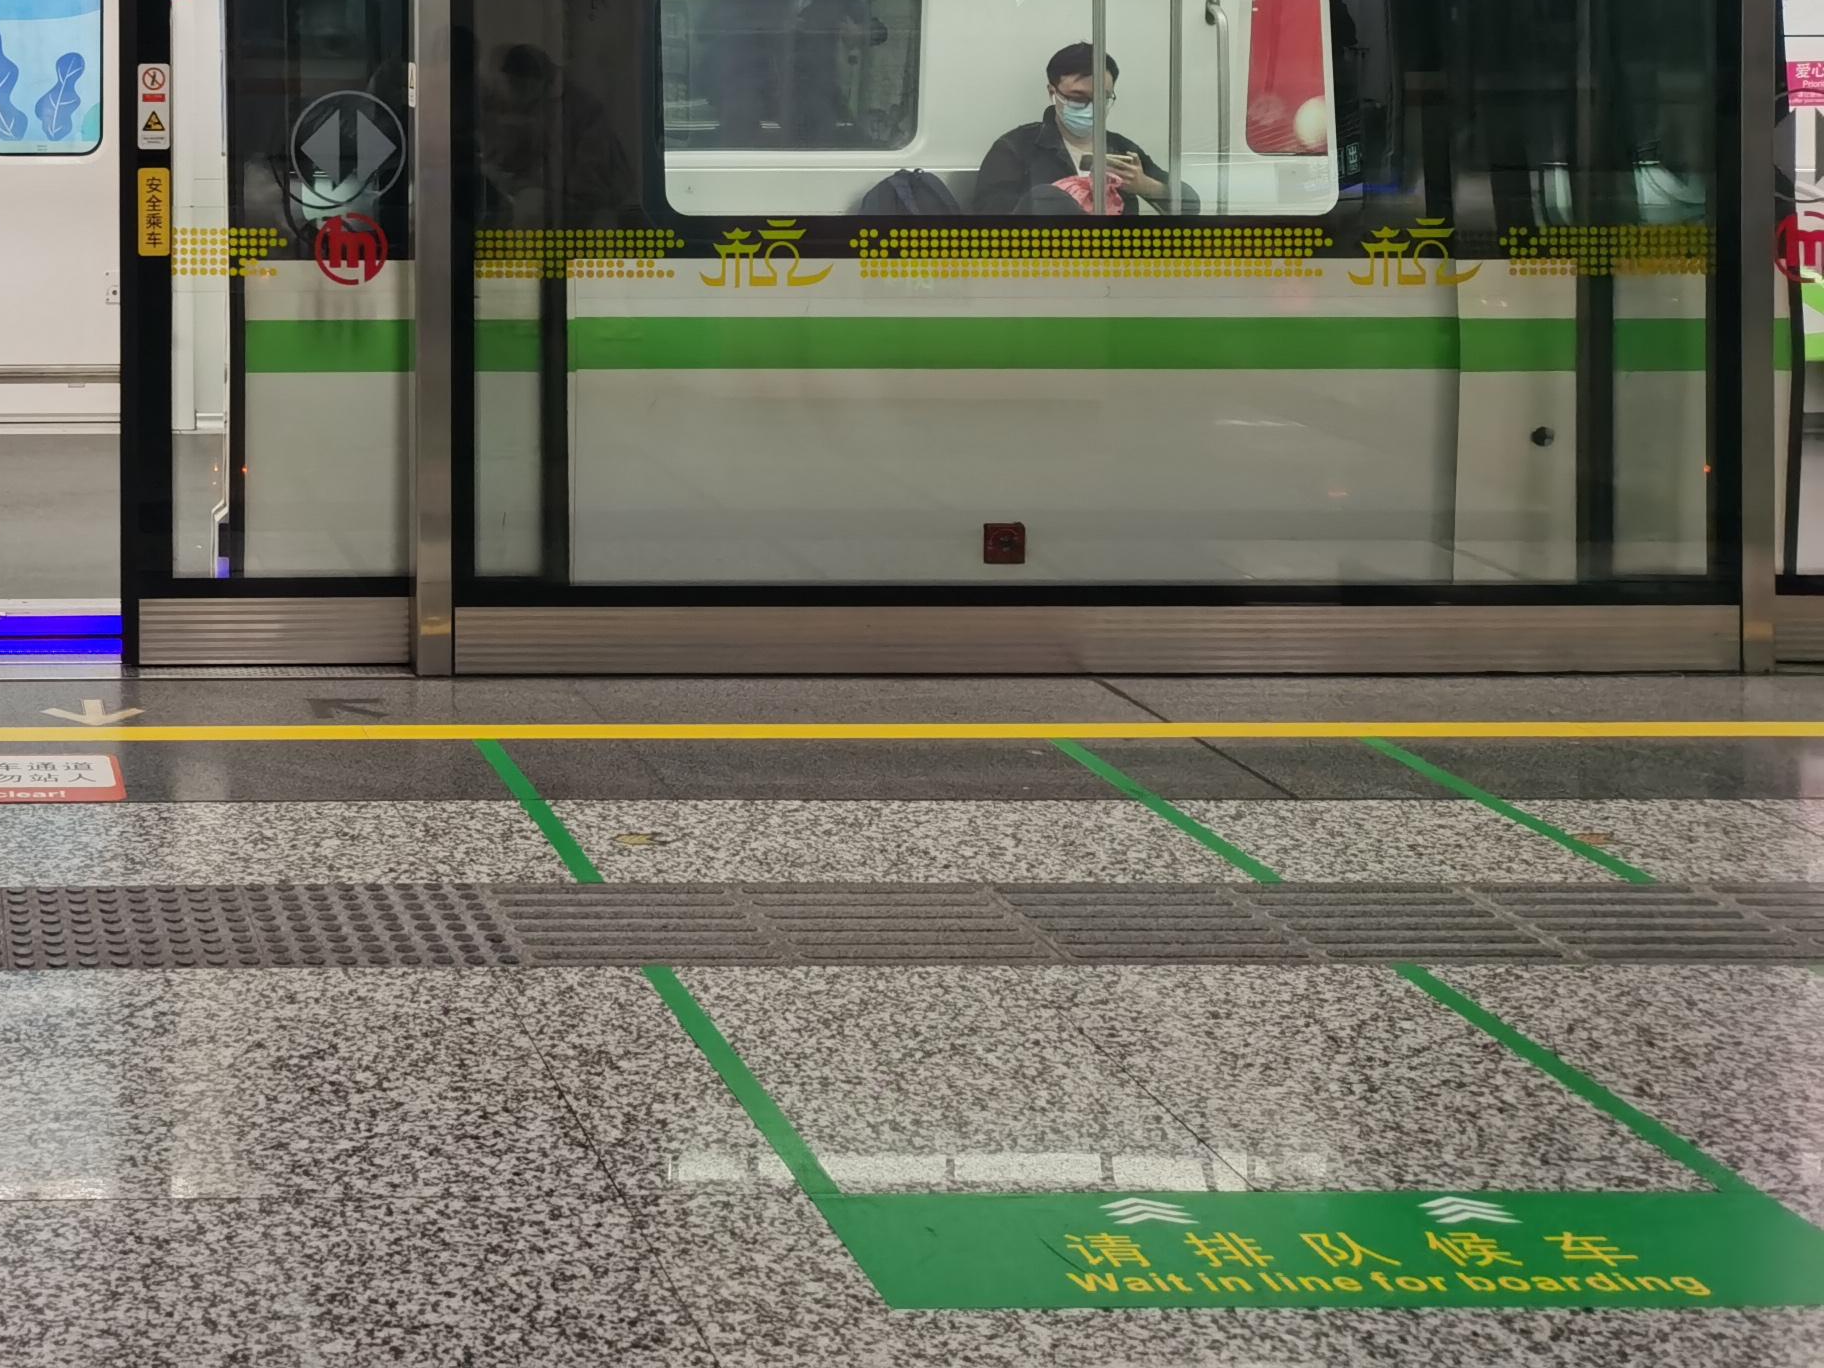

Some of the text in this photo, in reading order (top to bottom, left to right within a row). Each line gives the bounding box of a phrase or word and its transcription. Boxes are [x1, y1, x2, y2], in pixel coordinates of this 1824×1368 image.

[146, 176, 163, 249] 安全乘车
[1066, 1231, 1638, 1268] 请排队候车
[1066, 1271, 1712, 1297] Wait in line for boarding
